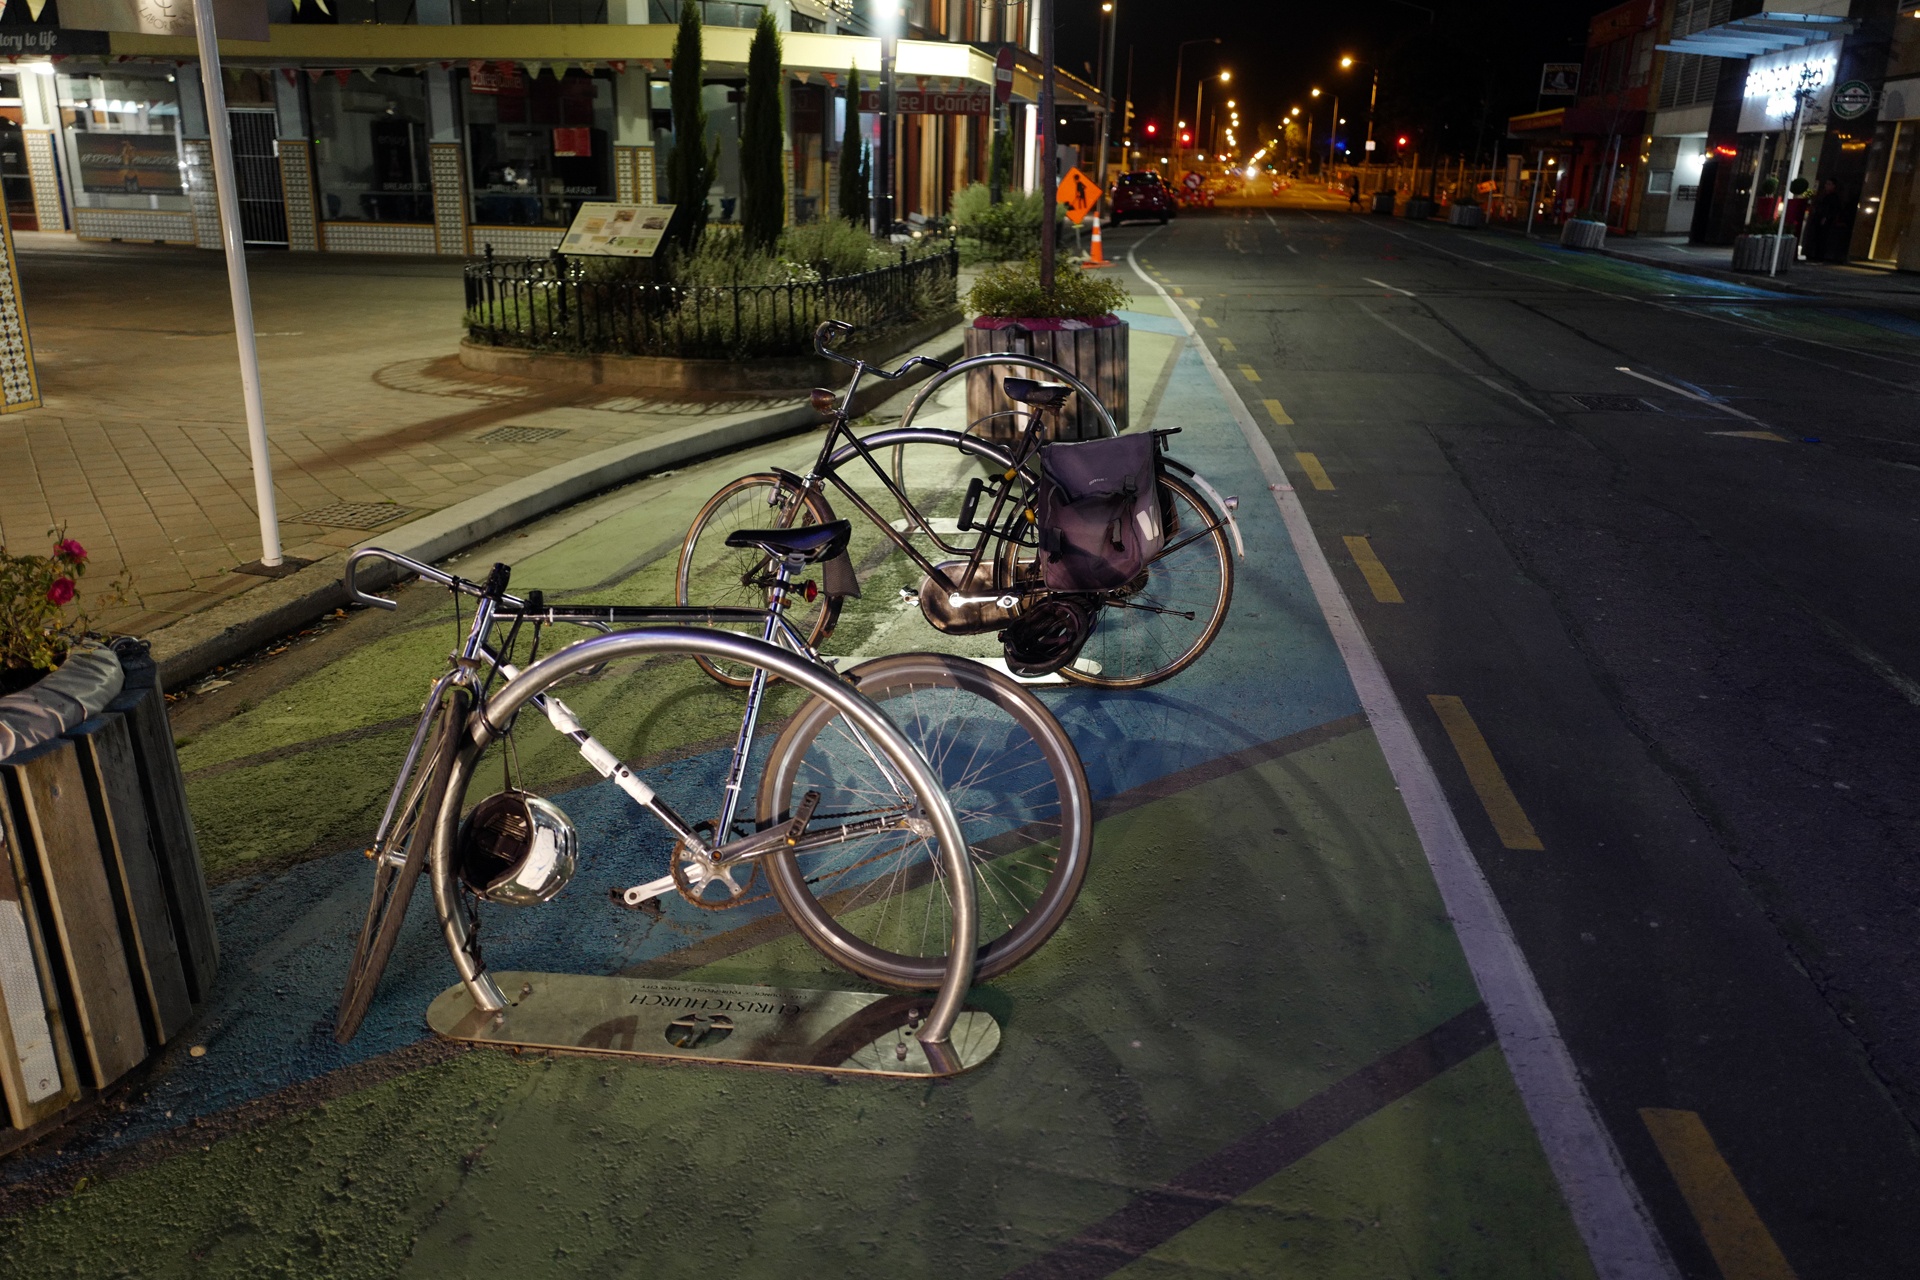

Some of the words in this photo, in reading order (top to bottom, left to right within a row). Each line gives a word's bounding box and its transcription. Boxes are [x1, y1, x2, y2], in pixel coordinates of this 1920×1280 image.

[25, 32, 37, 47] to
[39, 30, 58, 51] life
[934, 93, 987, 112] Corner
[549, 185, 598, 195] BREAKFAST
[629, 994, 801, 1015] CHRISTCHURCH
